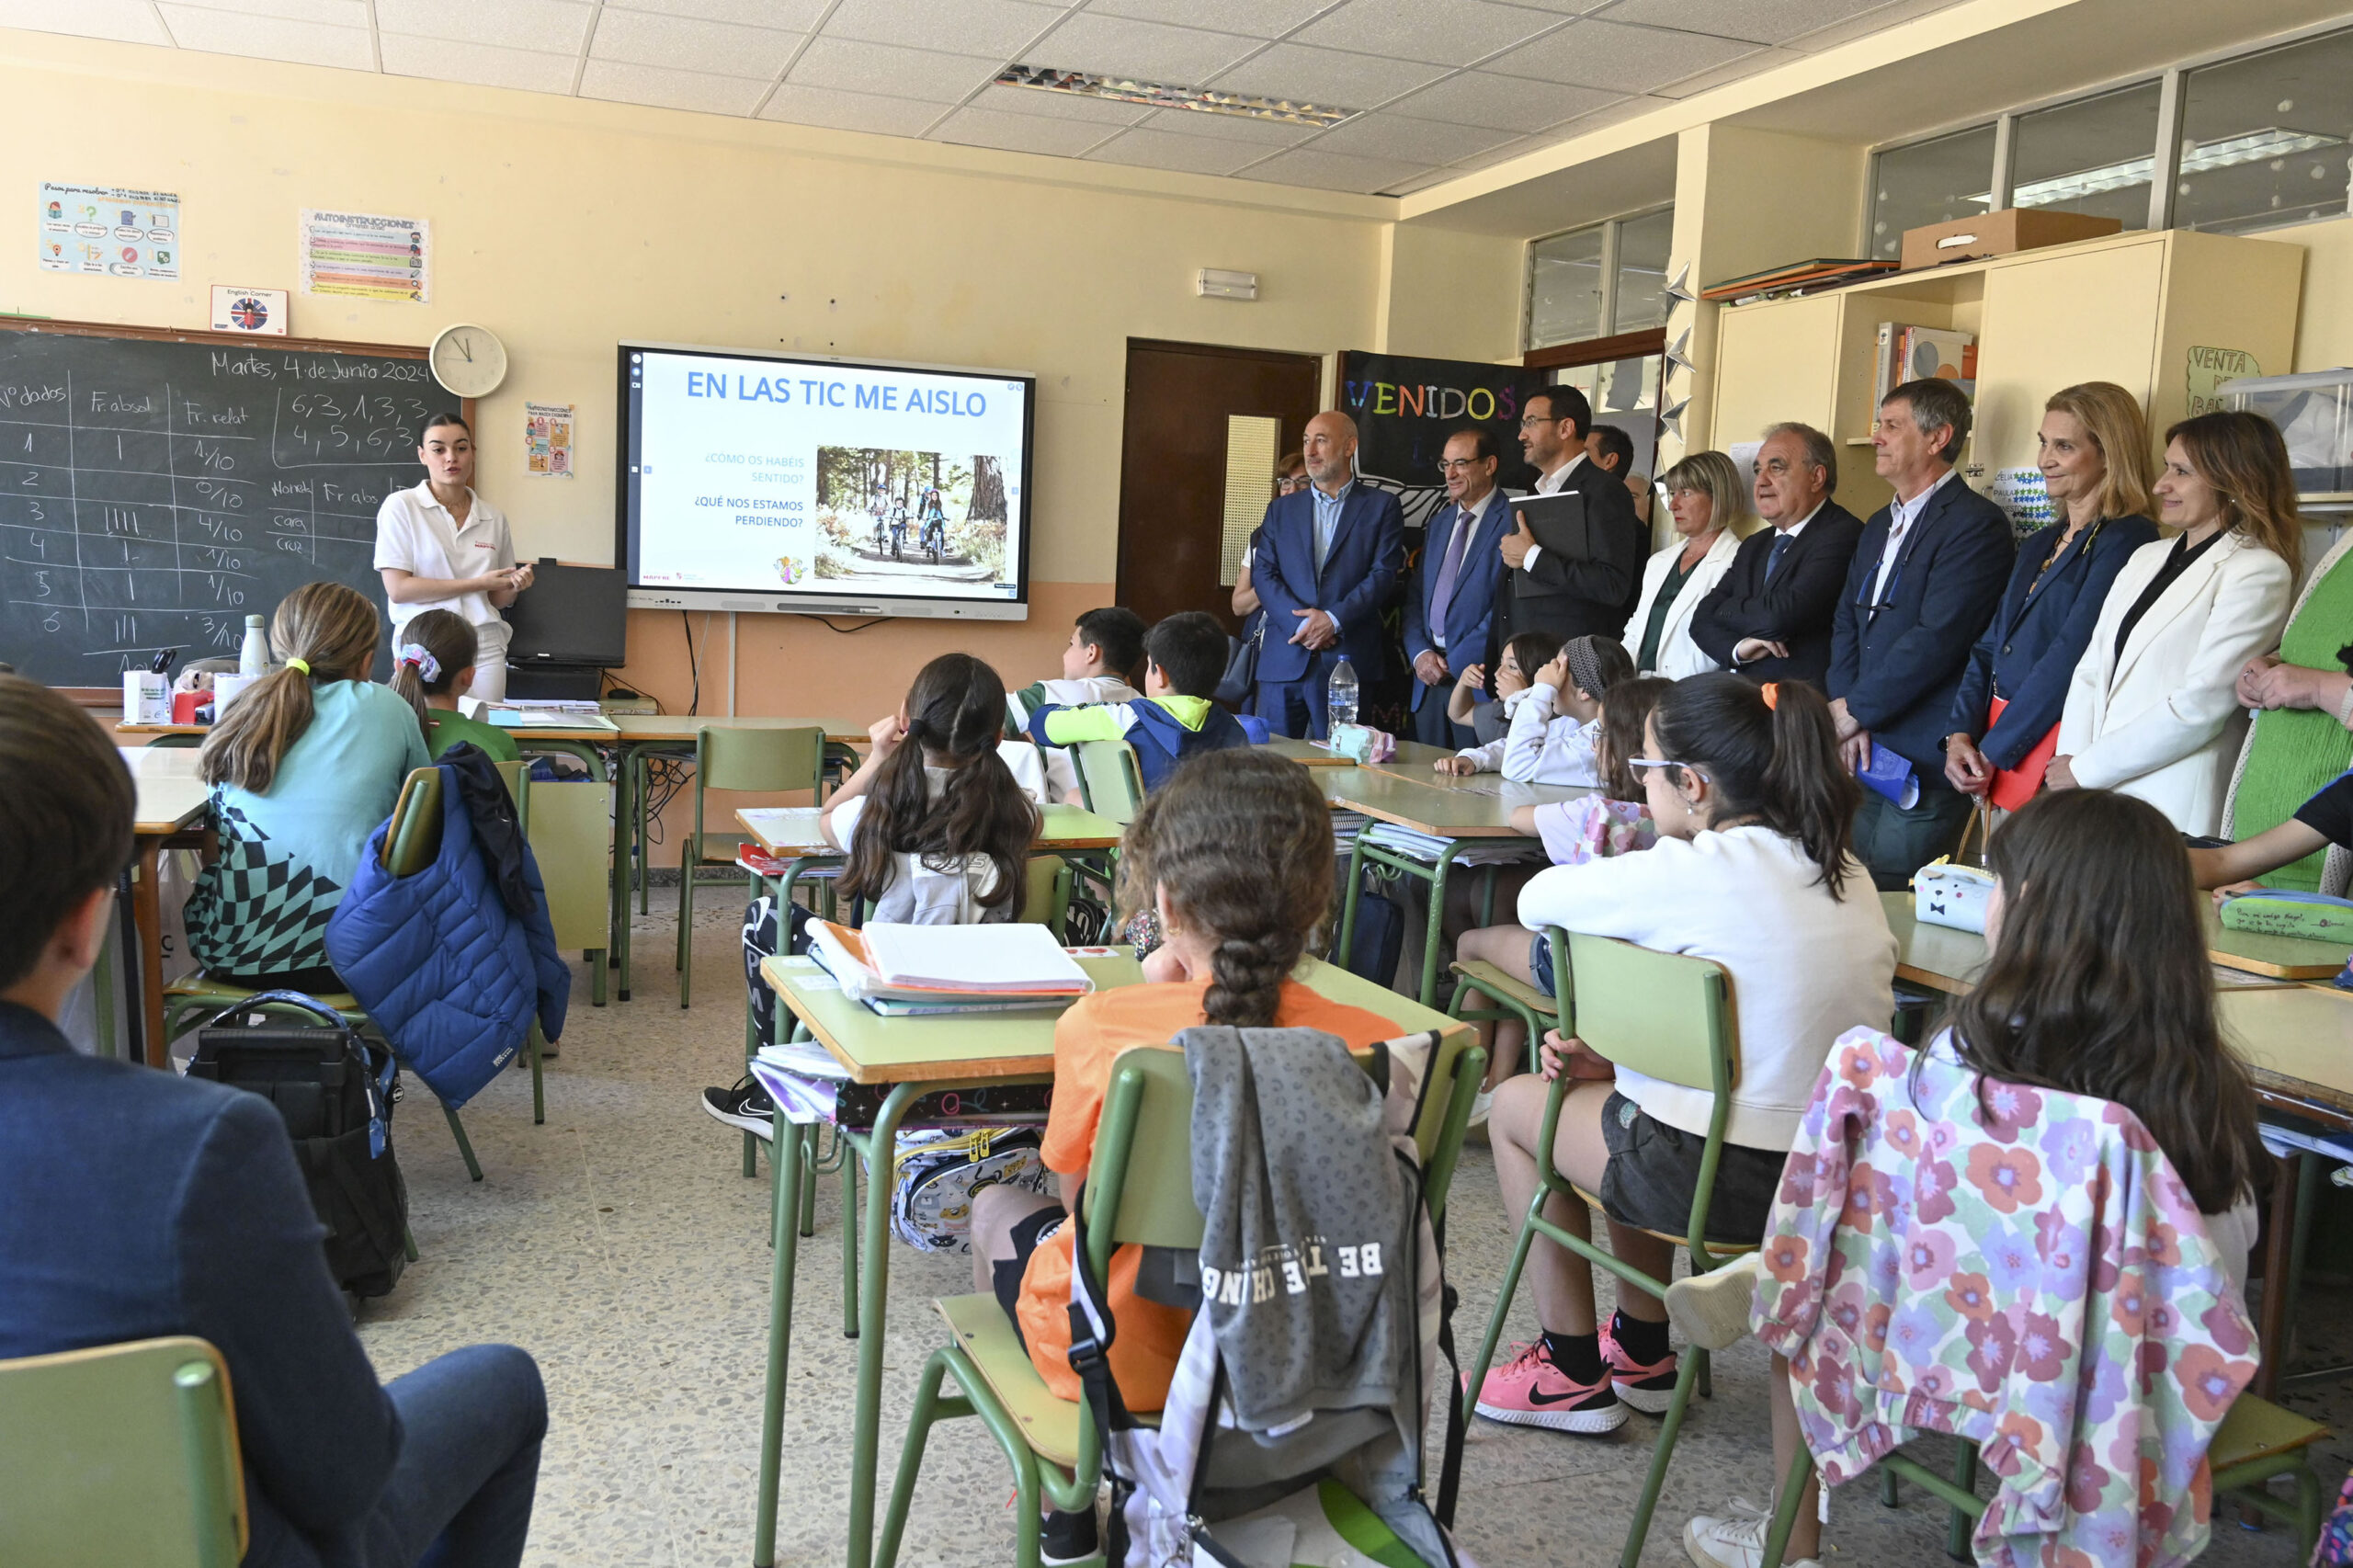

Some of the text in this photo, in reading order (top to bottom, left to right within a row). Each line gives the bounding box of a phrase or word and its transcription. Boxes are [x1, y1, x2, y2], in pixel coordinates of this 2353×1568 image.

[314, 213, 415, 229] AUTOINSTRUCCIONES
[211, 351, 277, 381] Martes,
[308, 360, 327, 380] de
[382, 361, 429, 382] 2024
[2193, 348, 2245, 373] VENTA
[20, 385, 67, 406] dados
[688, 371, 986, 417] EN LAS TIC ME AISLO
[1346, 380, 1517, 420] VENIDOS
[212, 407, 249, 425] relat
[24, 432, 32, 453] 1
[705, 453, 804, 468] ¿CÓMO OS HABÉIS
[21, 472, 40, 486] 2
[752, 472, 804, 484] SENTIDO?
[351, 488, 379, 505] abs
[695, 494, 803, 511] ¿QUÉ NOS ESTAMOS
[29, 502, 45, 521] 3
[735, 516, 803, 528] PERDIENDO?
[29, 531, 45, 559] 4
[42, 610, 61, 632] 6
[1338, 1242, 1383, 1278] BE
